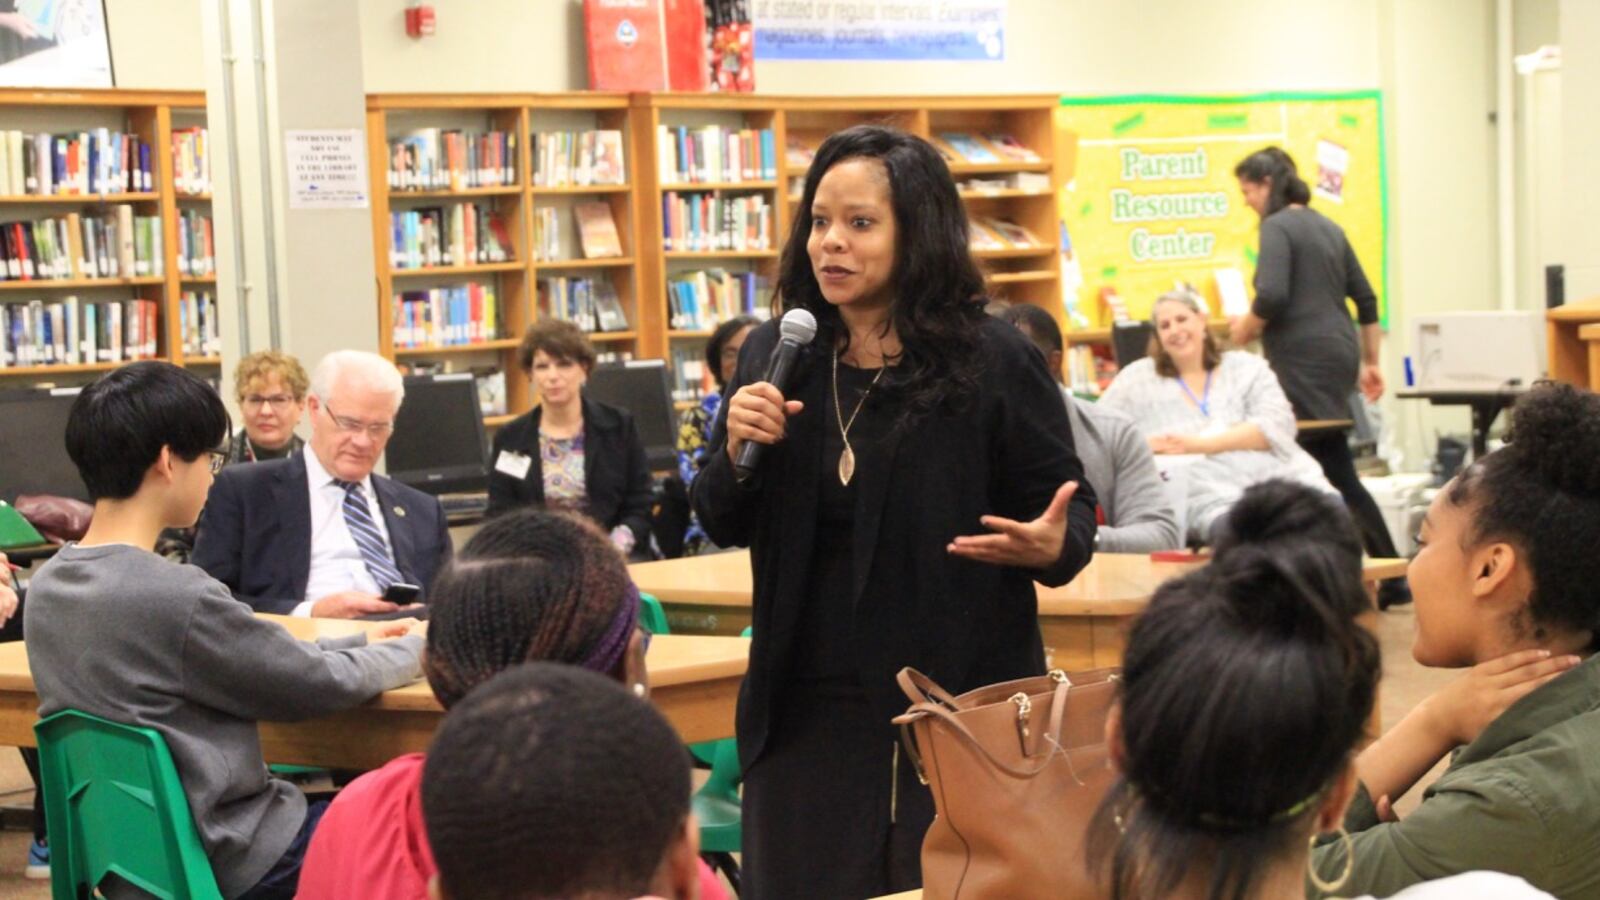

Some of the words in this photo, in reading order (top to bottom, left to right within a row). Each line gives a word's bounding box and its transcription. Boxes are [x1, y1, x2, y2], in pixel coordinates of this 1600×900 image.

[773, 1, 812, 19] stated
[815, 4, 830, 19] or
[834, 2, 875, 24] regular
[1122, 149, 1205, 180] Parent
[1113, 190, 1226, 220] Resource
[1131, 229, 1213, 261] Center
